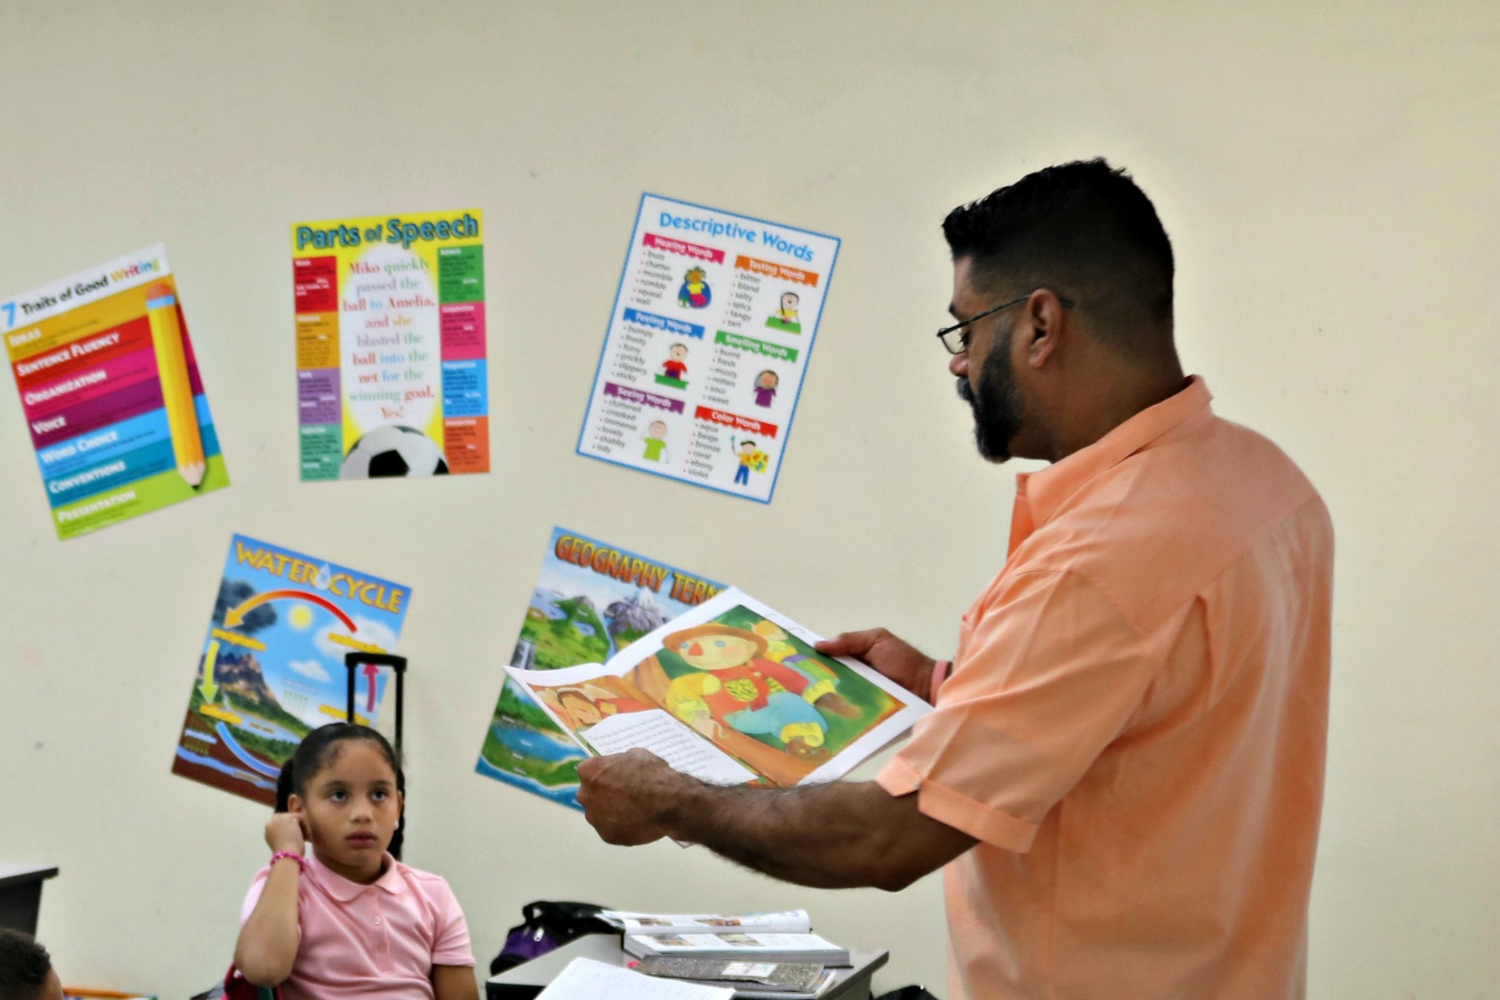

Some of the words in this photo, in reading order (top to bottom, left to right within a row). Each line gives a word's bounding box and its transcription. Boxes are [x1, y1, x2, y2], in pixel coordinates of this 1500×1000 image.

[296, 222, 360, 251] Parts
[386, 212, 479, 250] Speech
[658, 212, 757, 243] Descriptive
[763, 230, 814, 263] Words
[653, 237, 687, 252] Hearing
[687, 245, 713, 258] Words
[348, 260, 380, 275] Miko
[383, 256, 429, 276] quickly
[644, 260, 671, 272] chatter
[748, 259, 777, 274] Tasting
[778, 267, 805, 281] Words
[642, 269, 673, 282] mumble
[739, 273, 760, 283] bitter
[355, 278, 396, 295] passed
[399, 276, 420, 289] the
[640, 278, 666, 290] rumble
[737, 282, 759, 293] bland
[0, 301, 21, 329] 7
[20, 293, 58, 316] Traits
[57, 286, 73, 303] of
[73, 275, 109, 297] Good
[110, 257, 161, 283] Writing
[734, 291, 752, 302] salty
[342, 298, 367, 312] ball
[369, 298, 383, 310] to
[388, 293, 435, 310] Amelia,
[732, 301, 751, 312] spicy
[365, 315, 389, 328] and
[392, 313, 413, 327] she
[729, 310, 751, 322] tangy
[634, 312, 665, 328] Feeling
[666, 320, 692, 334] Words
[727, 319, 741, 328] tart
[356, 332, 400, 346] blasted
[403, 331, 423, 343] the
[627, 325, 653, 339] bumpy
[624, 335, 646, 346] frosty
[724, 335, 759, 350] Smelling
[760, 343, 788, 357] Words
[622, 344, 641, 354] furry
[719, 348, 741, 359] burnt
[352, 352, 377, 366] ball
[379, 350, 405, 364] into
[408, 348, 428, 362] the
[620, 353, 645, 365] prickly
[717, 357, 735, 367] fresh
[358, 372, 378, 383] net
[381, 369, 400, 382] for
[403, 366, 423, 381] the
[618, 362, 647, 375] slippery
[714, 367, 737, 378] musty
[615, 371, 636, 382] sticky
[712, 376, 735, 387] rotten
[348, 389, 401, 405] winning
[403, 384, 434, 401] goal.
[709, 386, 726, 394] sour
[616, 387, 644, 402] Seeing
[646, 394, 672, 408] Words
[707, 394, 729, 405] sweet
[380, 404, 404, 419] Yes!
[608, 399, 641, 413] cluttered
[606, 408, 636, 421] crooked
[711, 411, 734, 424] Color
[735, 417, 761, 430] Words
[603, 417, 637, 431] immense
[699, 423, 718, 433] aqua
[601, 426, 623, 438] lovely
[697, 432, 718, 443] beige
[599, 435, 625, 448] shabby
[695, 441, 721, 452] bronze
[692, 450, 711, 460] coral
[690, 459, 713, 471] ebony
[688, 468, 709, 478] violet
[555, 534, 669, 594] GEOGRAPHY
[231, 539, 320, 588] WATER
[326, 569, 405, 615] CYCLE
